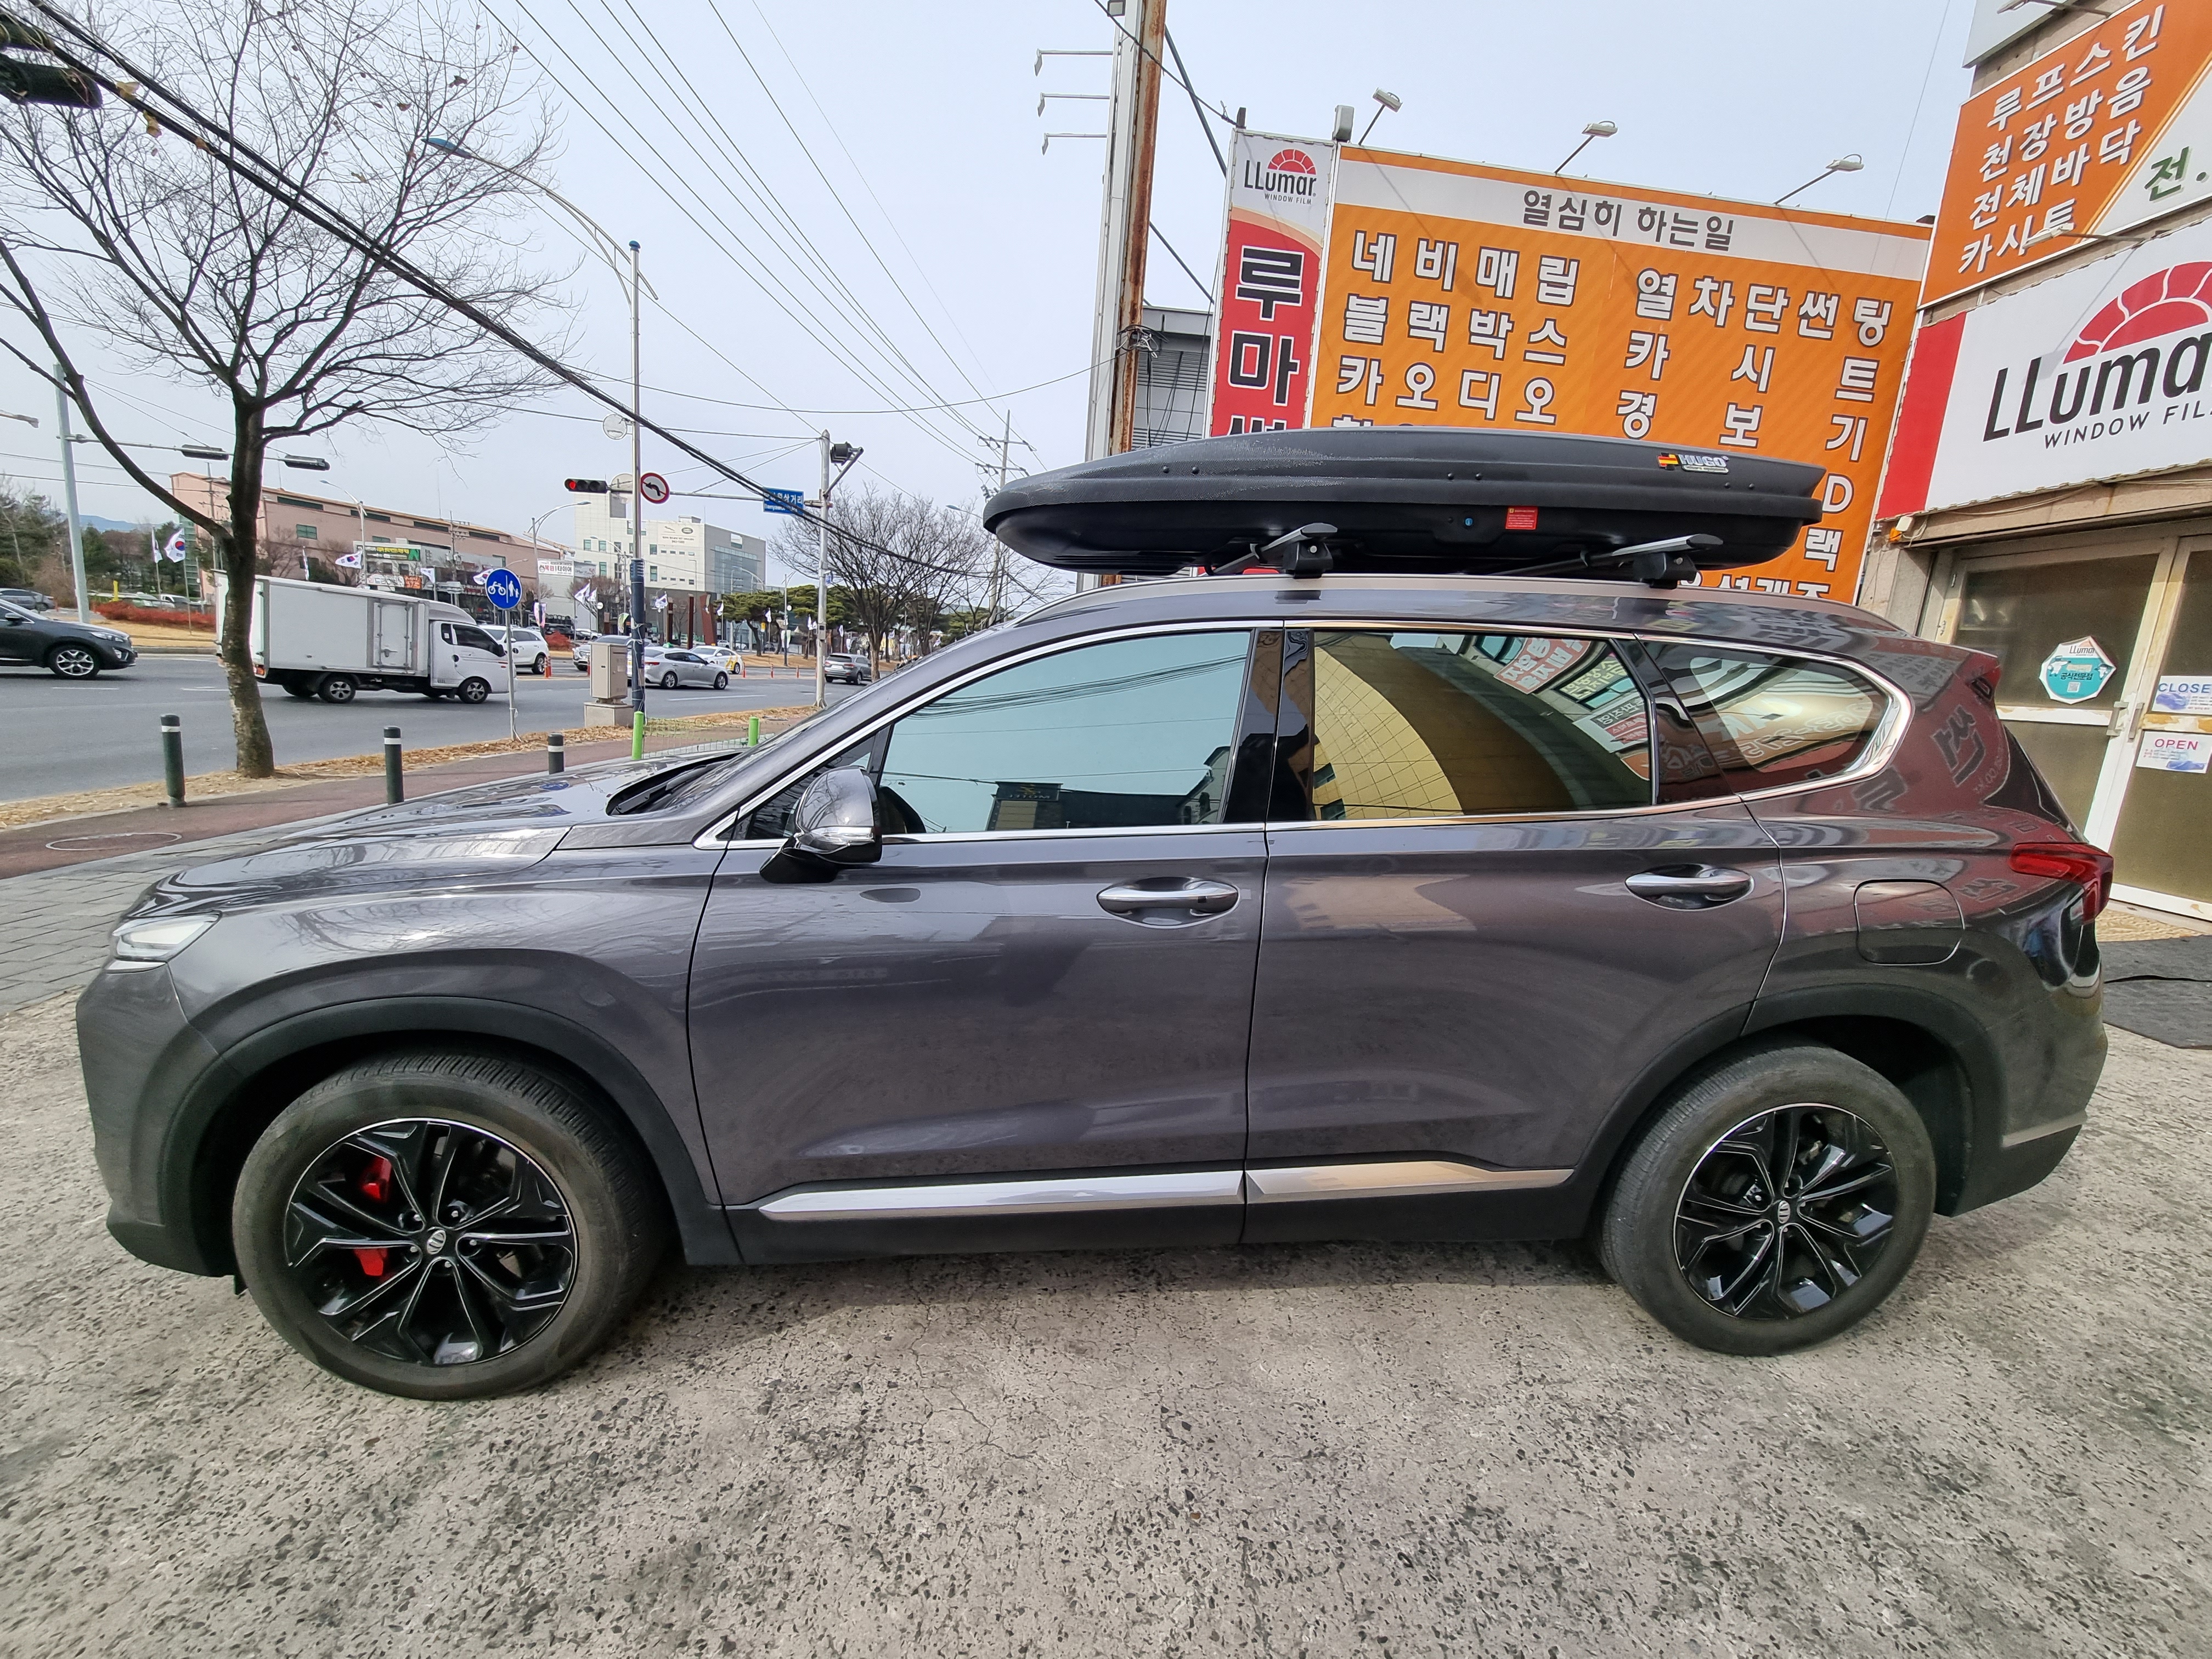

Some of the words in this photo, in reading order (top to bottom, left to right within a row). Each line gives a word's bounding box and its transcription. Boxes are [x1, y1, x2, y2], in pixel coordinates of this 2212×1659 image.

[1987, 4, 2165, 131] 루프스킨
[1979, 66, 2151, 183] 천장방음
[1244, 160, 1317, 196] LLumar
[1265, 193, 1293, 203] WINDOW
[1969, 119, 2141, 230] 전체바닥
[1523, 189, 1622, 236] 열심히
[1637, 206, 1734, 252] 하는일
[1957, 198, 2075, 274] 카시트
[1352, 230, 1580, 307] 네비매립
[1635, 268, 1893, 347] 열차단썬팅
[1343, 294, 1568, 366] 블랙박스
[1624, 330, 1880, 402] 카시트
[1983, 332, 2212, 442] LLuma
[1336, 355, 1558, 425] 카오디오
[1616, 390, 1869, 462] 경보기
[2044, 411, 2151, 449] WINDOW
[2163, 400, 2212, 425] FIL
[2158, 682, 2211, 693] CLOSE
[2154, 738, 2198, 751] OPEN
